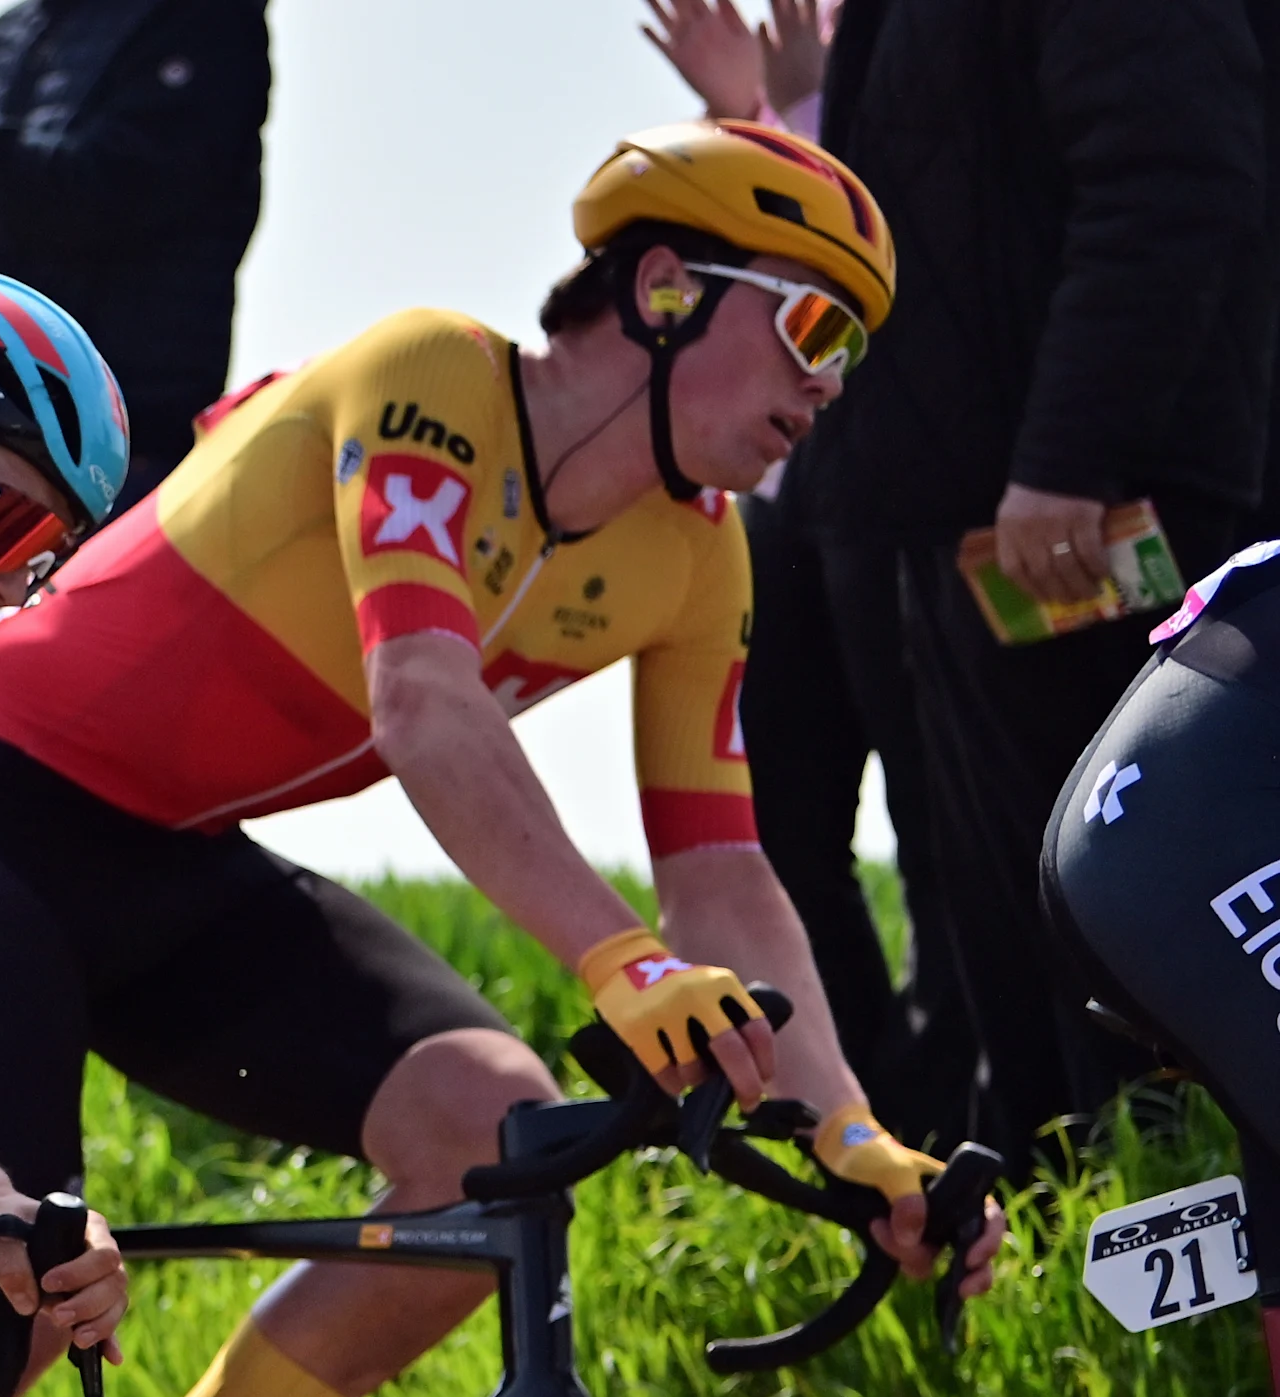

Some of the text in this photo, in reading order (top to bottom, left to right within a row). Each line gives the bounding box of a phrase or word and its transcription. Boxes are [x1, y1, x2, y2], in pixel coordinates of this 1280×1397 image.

[378, 402, 476, 465] Uno
[373, 473, 469, 568] X
[1103, 1210, 1231, 1258] OAKLEY OAKLEY
[1144, 1237, 1216, 1321] 21
